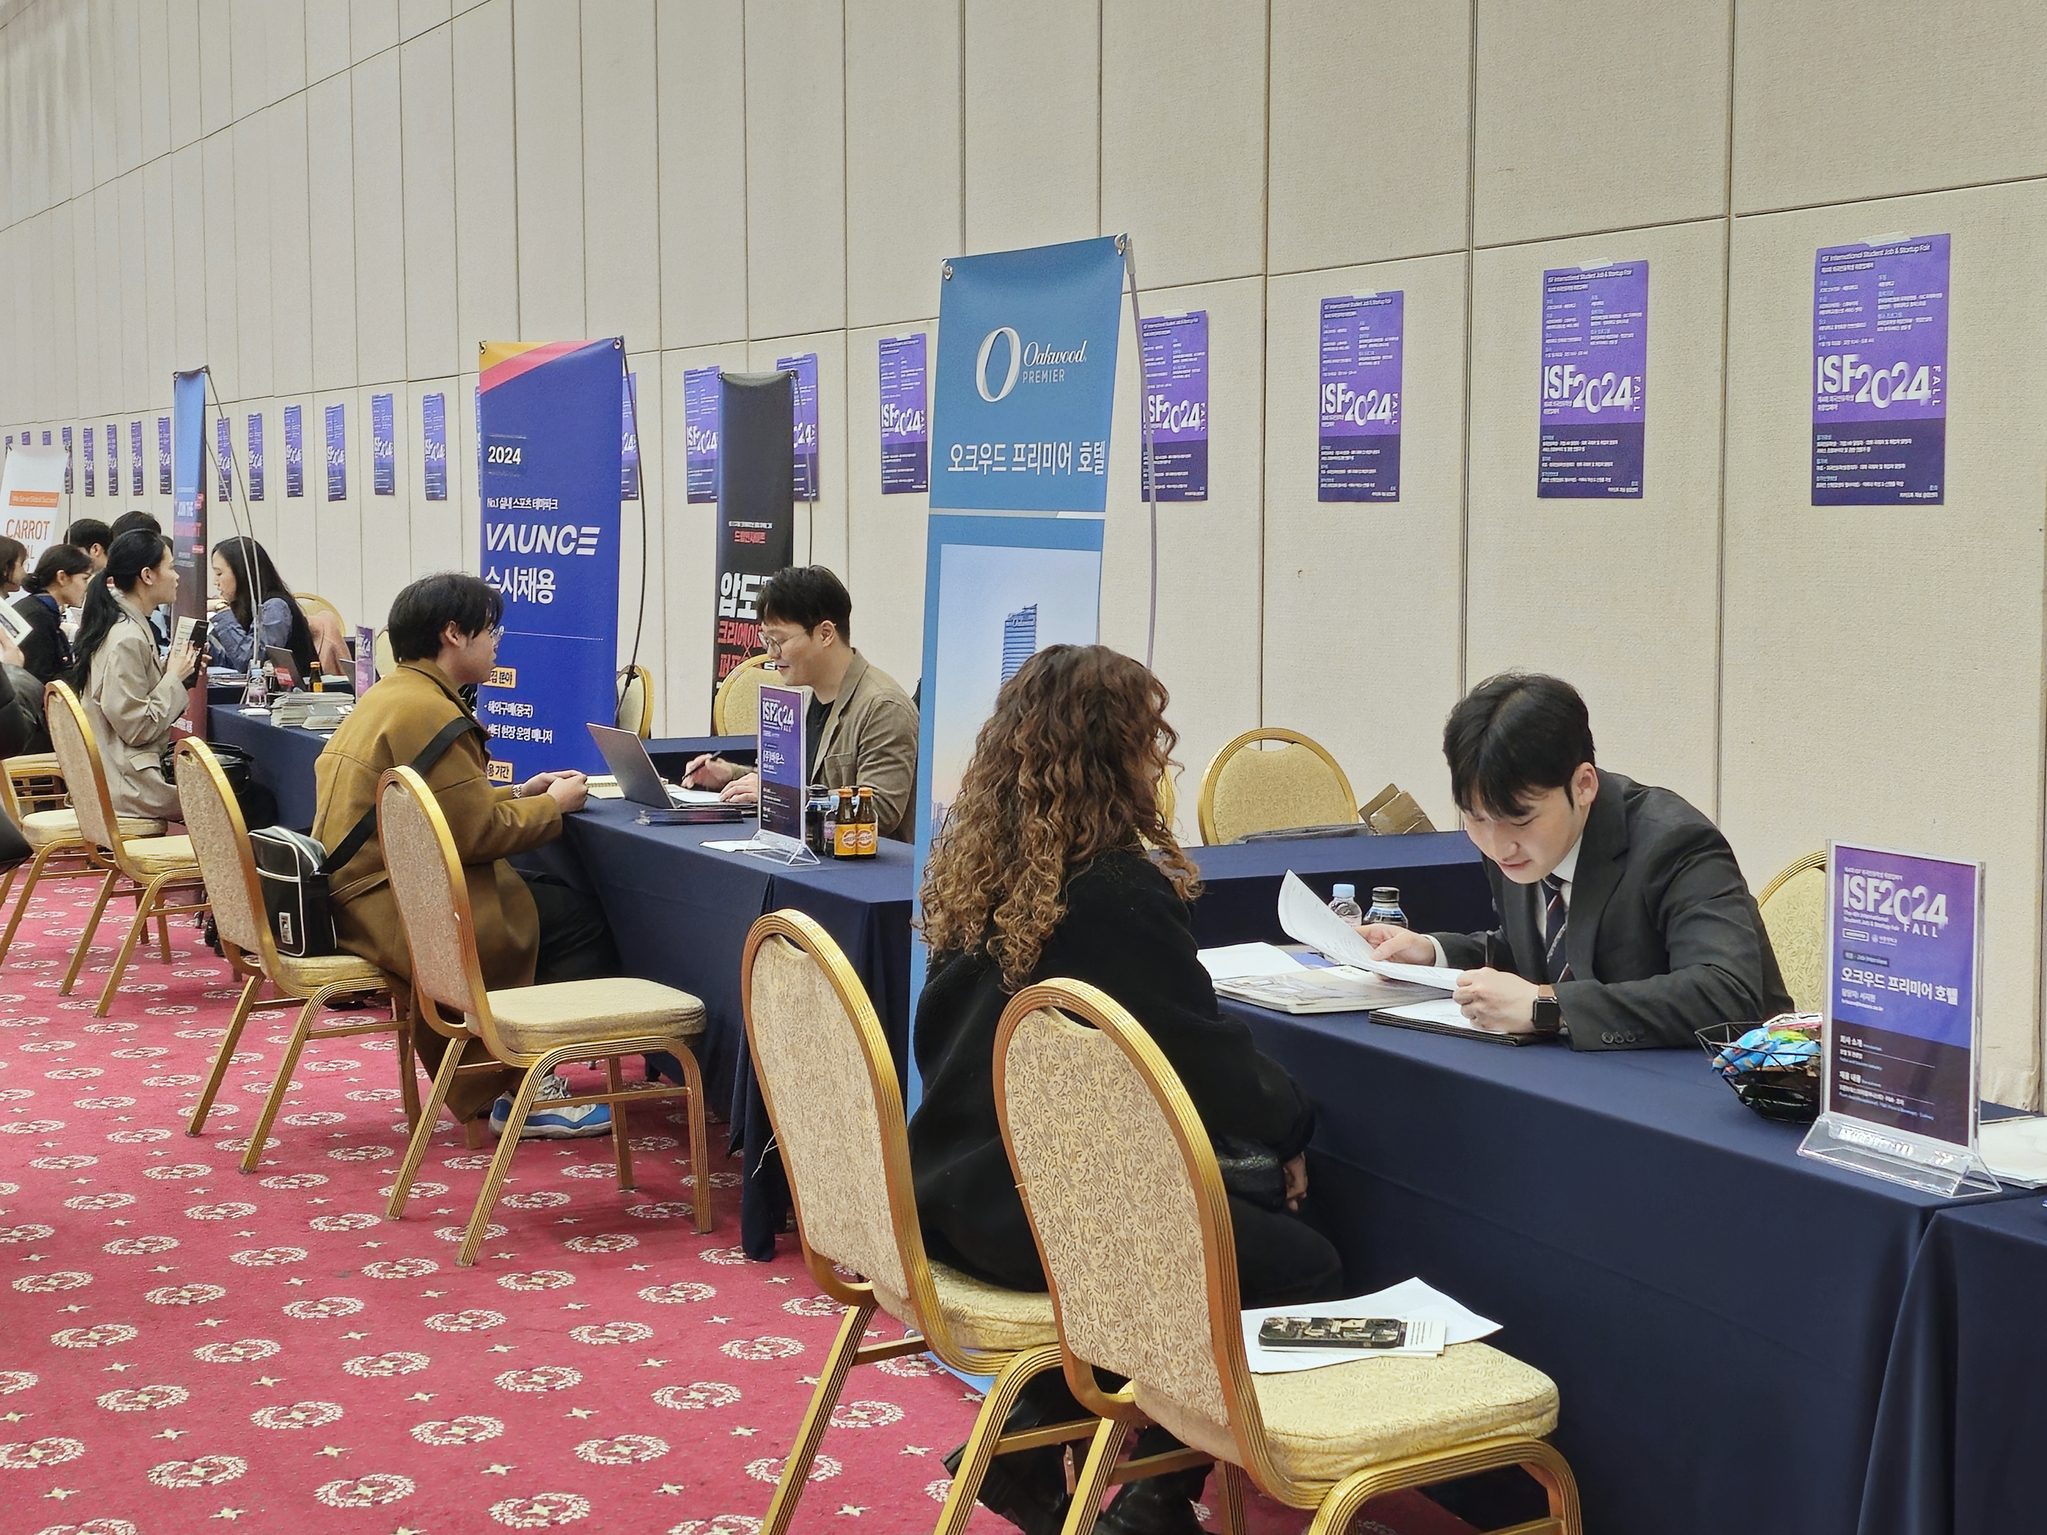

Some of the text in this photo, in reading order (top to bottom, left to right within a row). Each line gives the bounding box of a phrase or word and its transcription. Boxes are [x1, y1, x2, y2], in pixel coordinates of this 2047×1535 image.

[1023, 340, 1088, 367] Oakwood
[1022, 368, 1065, 384] PREMIER
[1933, 365, 1942, 406] FALL
[1143, 394, 1201, 433] SF2024
[487, 445, 522, 465] 2024
[947, 442, 1007, 476] 오크우드
[1011, 441, 1072, 476] 프리미어
[1077, 439, 1107, 476] 호텔
[512, 497, 532, 509] 스포츠
[6, 518, 50, 541] CARROT
[486, 522, 601, 556] VAUNCE
[718, 571, 774, 620] 압도
[717, 620, 763, 649] 크리에이
[495, 764, 510, 779] 기간
[1903, 922, 1938, 938] FALL
[1841, 966, 1886, 989] 오크우드
[1887, 975, 1933, 1001] 프리미어
[1934, 984, 1959, 1006] 호텔
